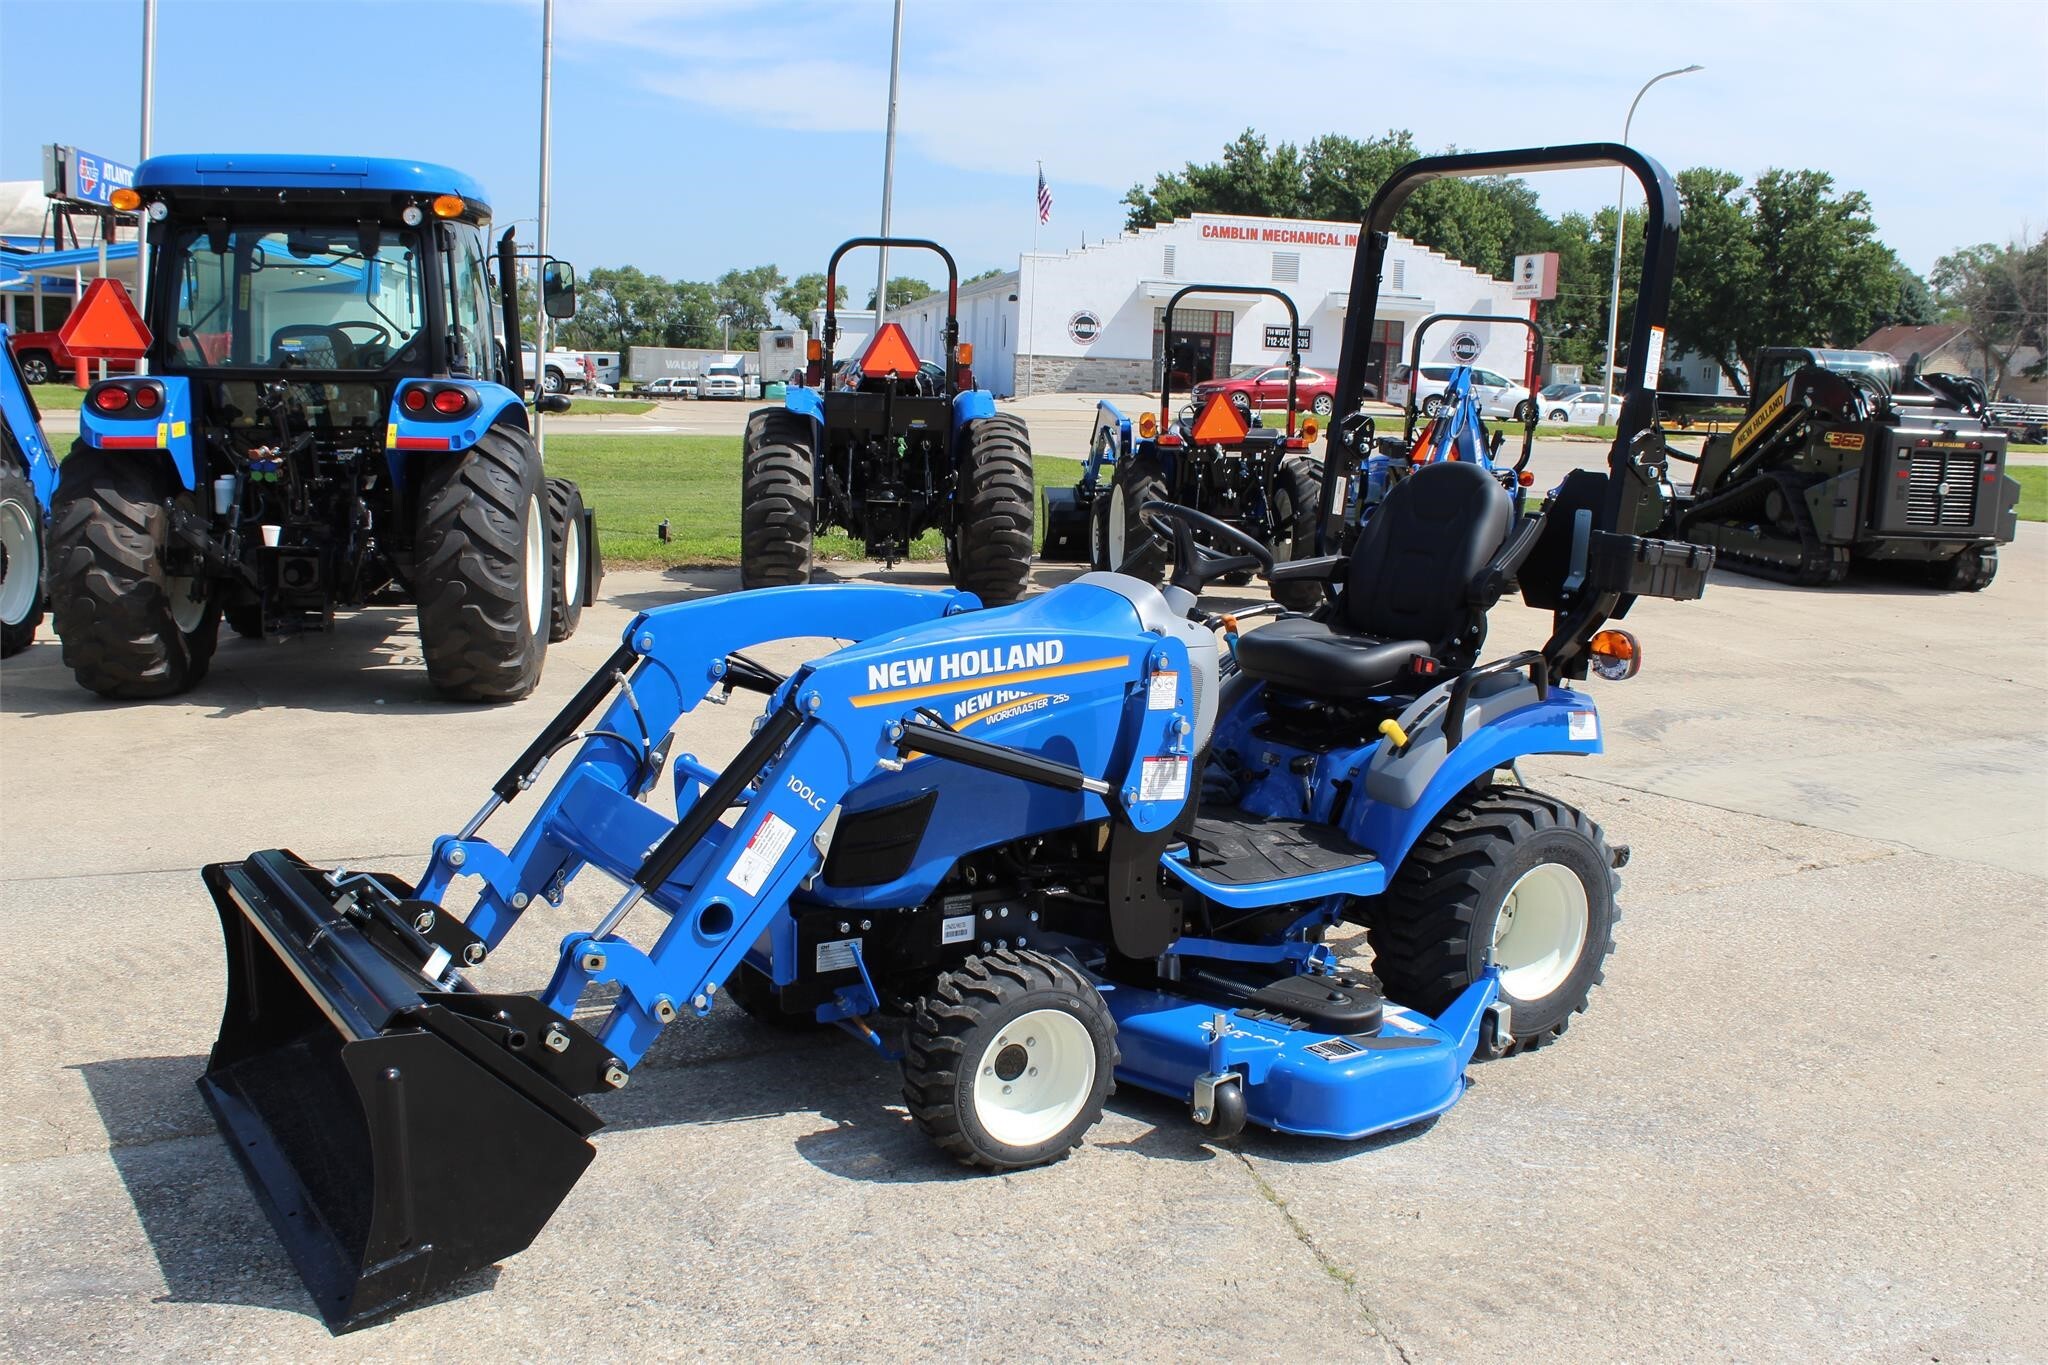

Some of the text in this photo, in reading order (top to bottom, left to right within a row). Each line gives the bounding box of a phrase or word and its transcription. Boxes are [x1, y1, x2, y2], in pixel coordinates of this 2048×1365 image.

[1202, 225, 1358, 247] CAMBLIN MECHANICAL IN
[1737, 395, 1783, 447] NEW HOLLAND
[868, 639, 1064, 690] NEW HOLLAND
[954, 690, 993, 720] NEW
[985, 698, 1049, 725] WORKMASTER
[786, 774, 827, 811] 100LC
